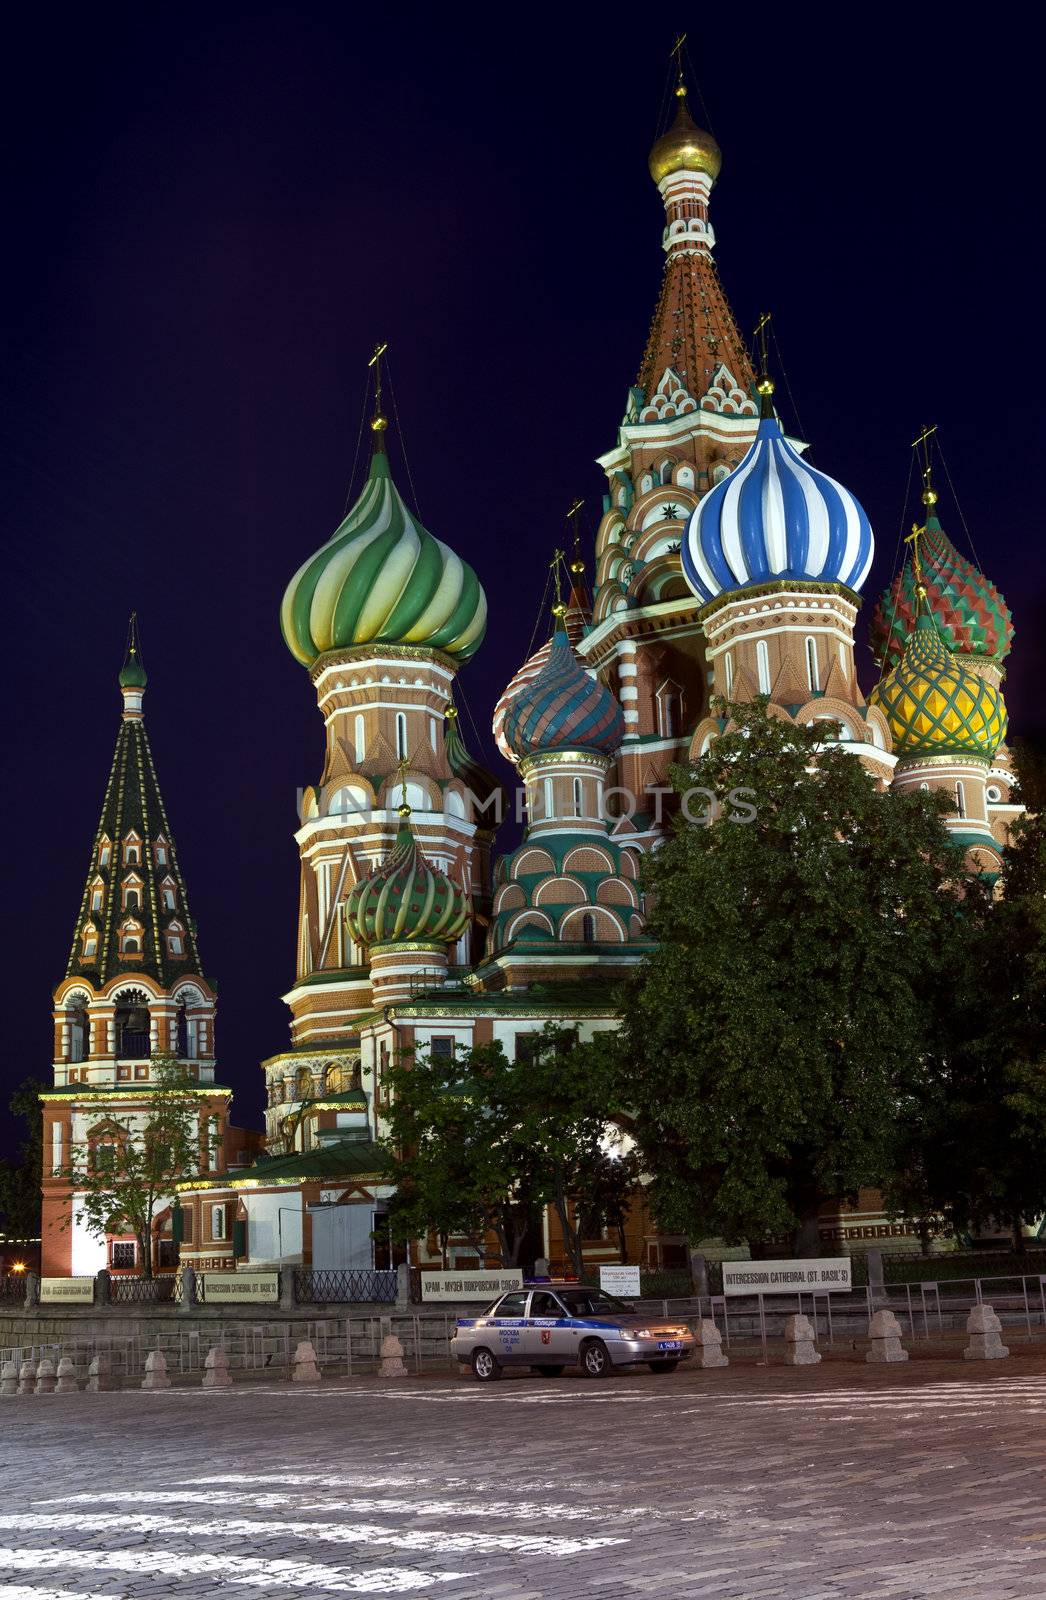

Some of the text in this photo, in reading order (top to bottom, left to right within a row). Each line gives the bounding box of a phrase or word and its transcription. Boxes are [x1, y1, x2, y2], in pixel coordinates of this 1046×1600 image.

[726, 1272, 769, 1284] INTERCESSION
[770, 1271, 806, 1283] CATHEDRAL
[498, 1329, 520, 1337] МОСКВА
